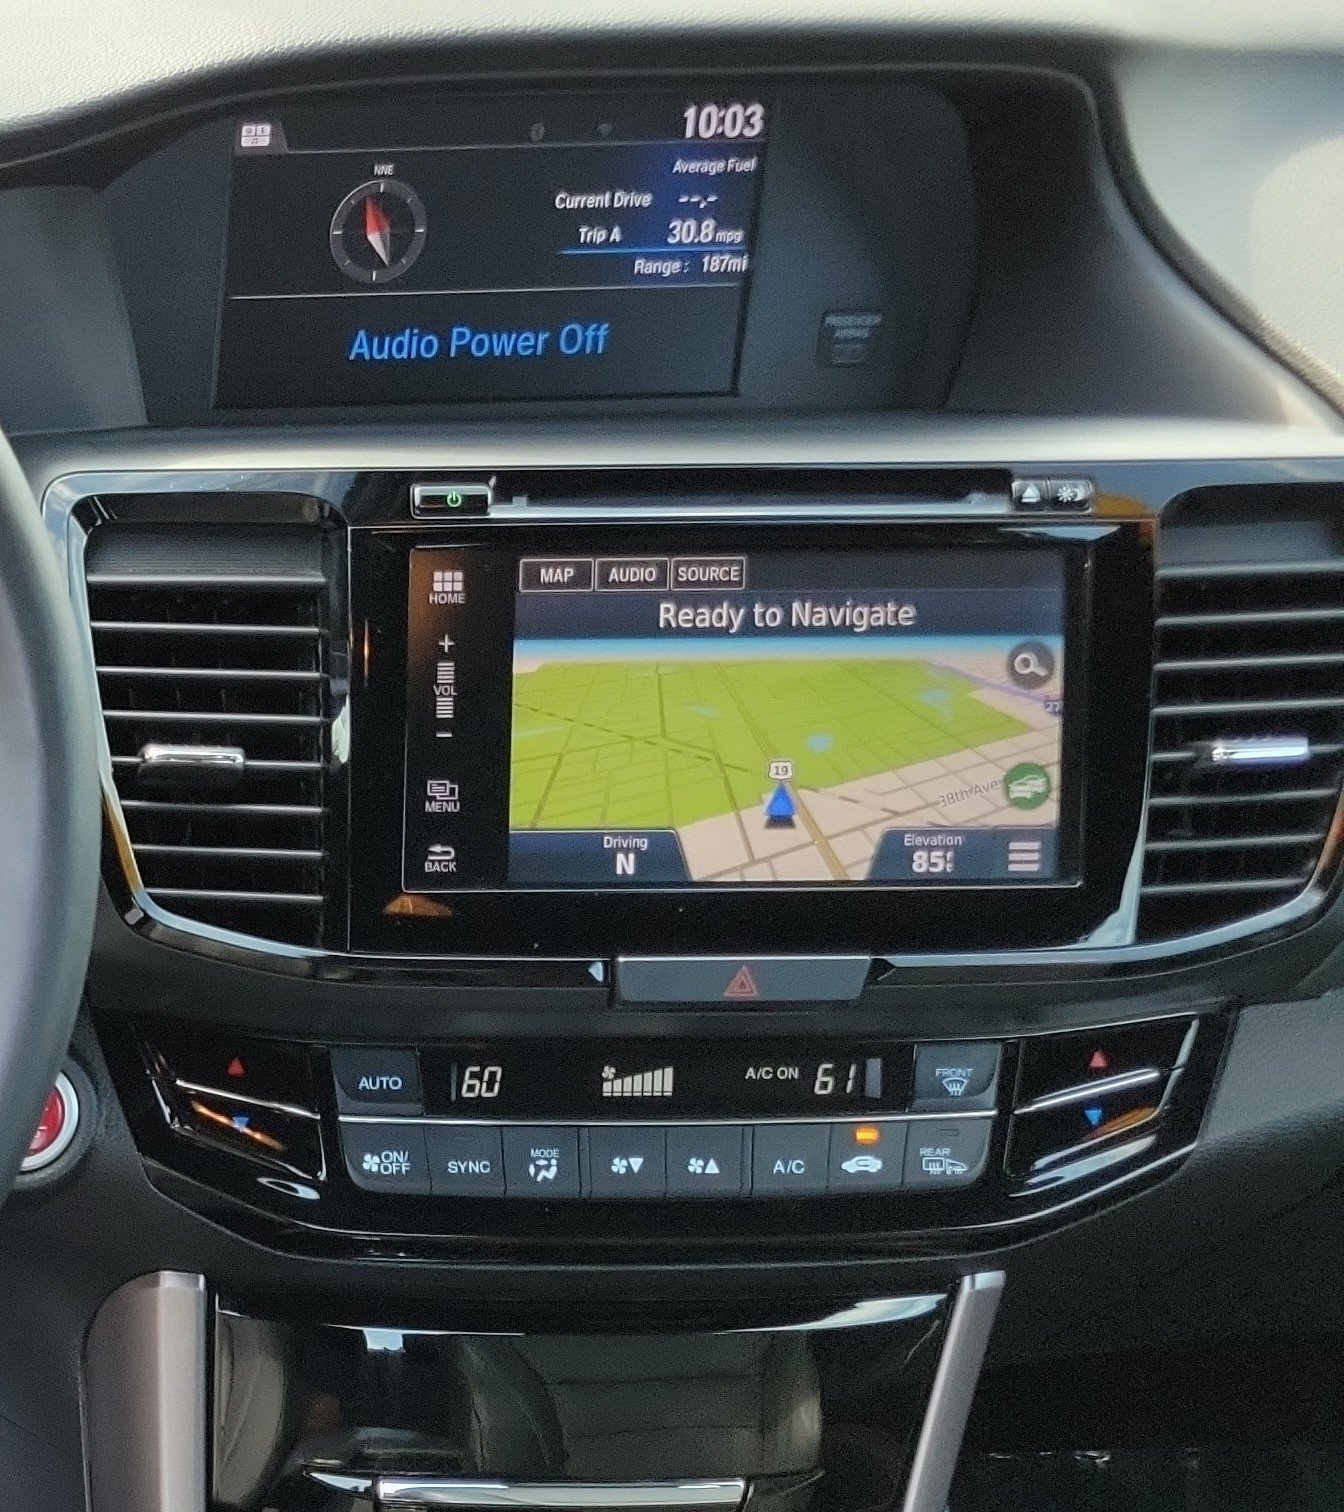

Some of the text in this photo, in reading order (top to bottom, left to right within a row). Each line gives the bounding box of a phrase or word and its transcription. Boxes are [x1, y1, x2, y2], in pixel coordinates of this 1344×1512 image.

[684, 103, 765, 139] 10:03
[673, 155, 758, 176] Average Fuel
[555, 190, 610, 210] Current
[613, 191, 653, 209] Drive
[579, 218, 744, 245] Trip A 30.8 mpg
[349, 322, 610, 361] Audio Power Off
[540, 567, 574, 584] MAP
[608, 566, 657, 584] AUDIO
[677, 566, 741, 582] SOURCE
[428, 593, 466, 604] HOME
[659, 600, 916, 634] Ready to Navigate
[433, 684, 458, 696] VOL
[773, 765, 789, 776] 19
[425, 801, 460, 813] MENU
[603, 836, 648, 851] Driving
[904, 833, 963, 847] Elevation
[424, 861, 457, 873] BACK
[616, 853, 635, 875] N
[745, 1066, 799, 1080] A/C ON
[814, 1063, 857, 1095] 61
[935, 1068, 973, 1078] FRONT
[358, 1076, 403, 1091] AUTO
[462, 1065, 503, 1098] 60
[380, 1150, 409, 1163] ON/
[530, 1148, 560, 1159] MODE
[919, 1147, 951, 1157] REAR
[379, 1162, 411, 1175] OFF
[447, 1160, 491, 1174] SYNC
[773, 1160, 805, 1174] A/C
